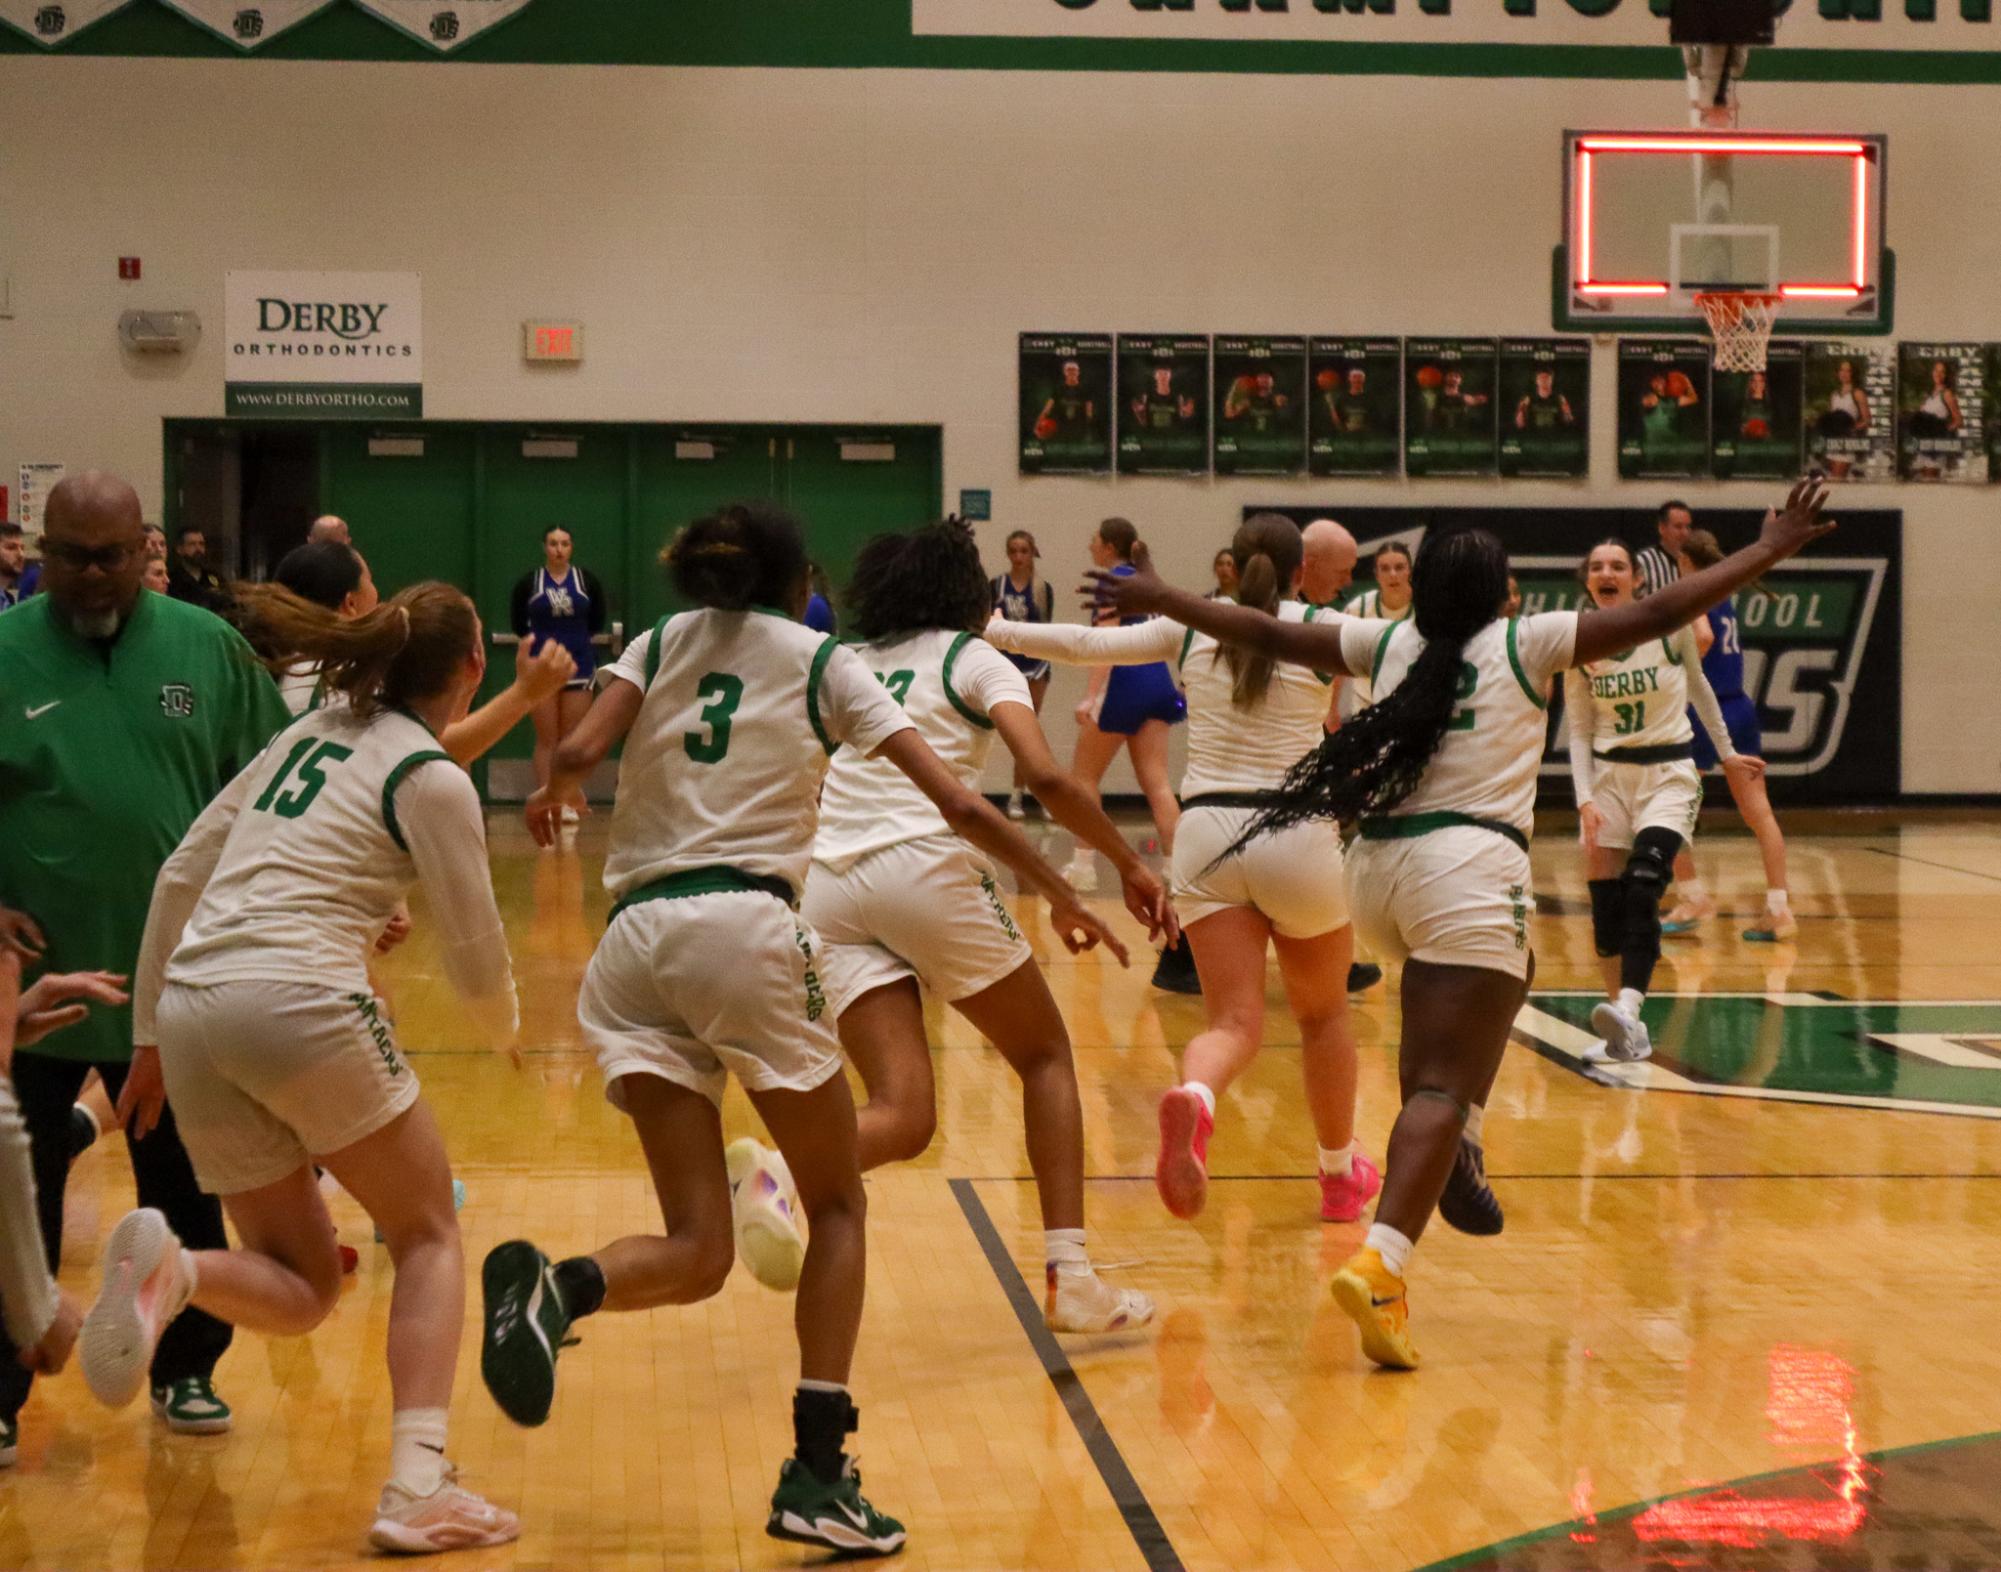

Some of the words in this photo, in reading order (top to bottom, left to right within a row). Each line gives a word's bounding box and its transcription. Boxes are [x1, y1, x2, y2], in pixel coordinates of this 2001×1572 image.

[256, 298, 388, 340] DERBY
[233, 343, 413, 356] ORTHODONTICS
[536, 327, 574, 355] EXIT
[236, 393, 410, 407] WWW.DERBYORTHO.COM
[1593, 666, 1659, 699] DERBY
[684, 671, 744, 765] 3
[1614, 701, 1646, 735] 31
[253, 736, 354, 819] 15
